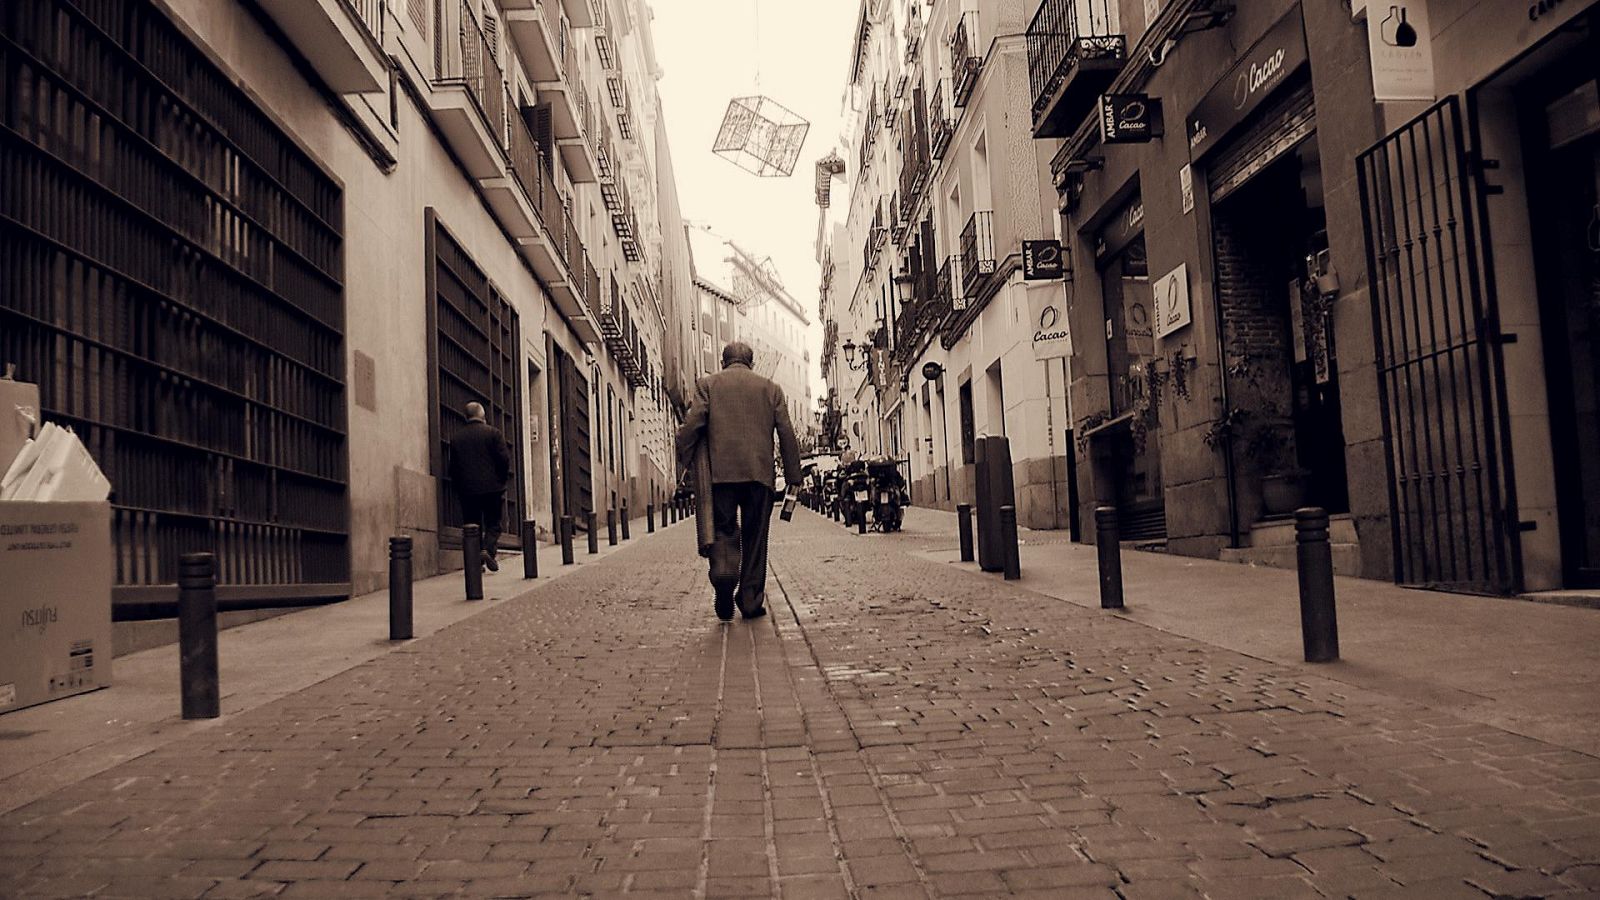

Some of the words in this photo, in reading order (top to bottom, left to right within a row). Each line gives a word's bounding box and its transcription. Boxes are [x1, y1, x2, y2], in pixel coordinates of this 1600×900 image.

[1250, 48, 1285, 92] Cacao
[1105, 103, 1116, 139] AMBAR
[1119, 120, 1147, 129] Cacao
[1036, 262, 1058, 270] Cacao
[1034, 331, 1069, 343] Cacao
[22, 604, 57, 627] FUJITSU
